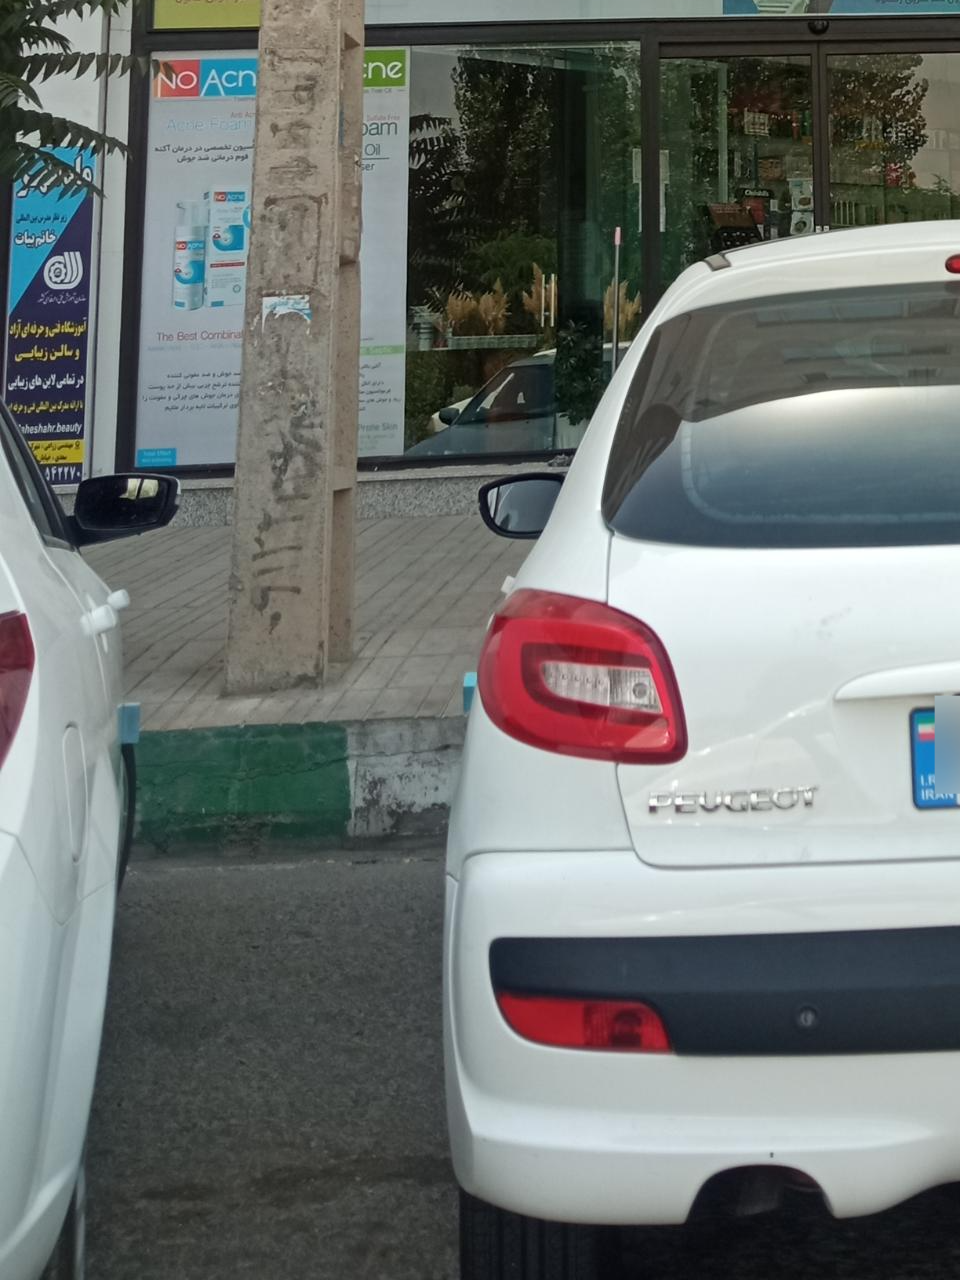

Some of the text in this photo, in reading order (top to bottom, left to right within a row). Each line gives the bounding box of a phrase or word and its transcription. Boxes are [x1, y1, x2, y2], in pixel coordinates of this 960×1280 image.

[200, 68, 257, 97] Acn
[362, 121, 398, 136] oam
[364, 143, 381, 157] Oil
[177, 331, 198, 341] Best
[18, 421, 83, 435] aheshahr.beauty
[648, 785, 818, 814] PEUGEOT
